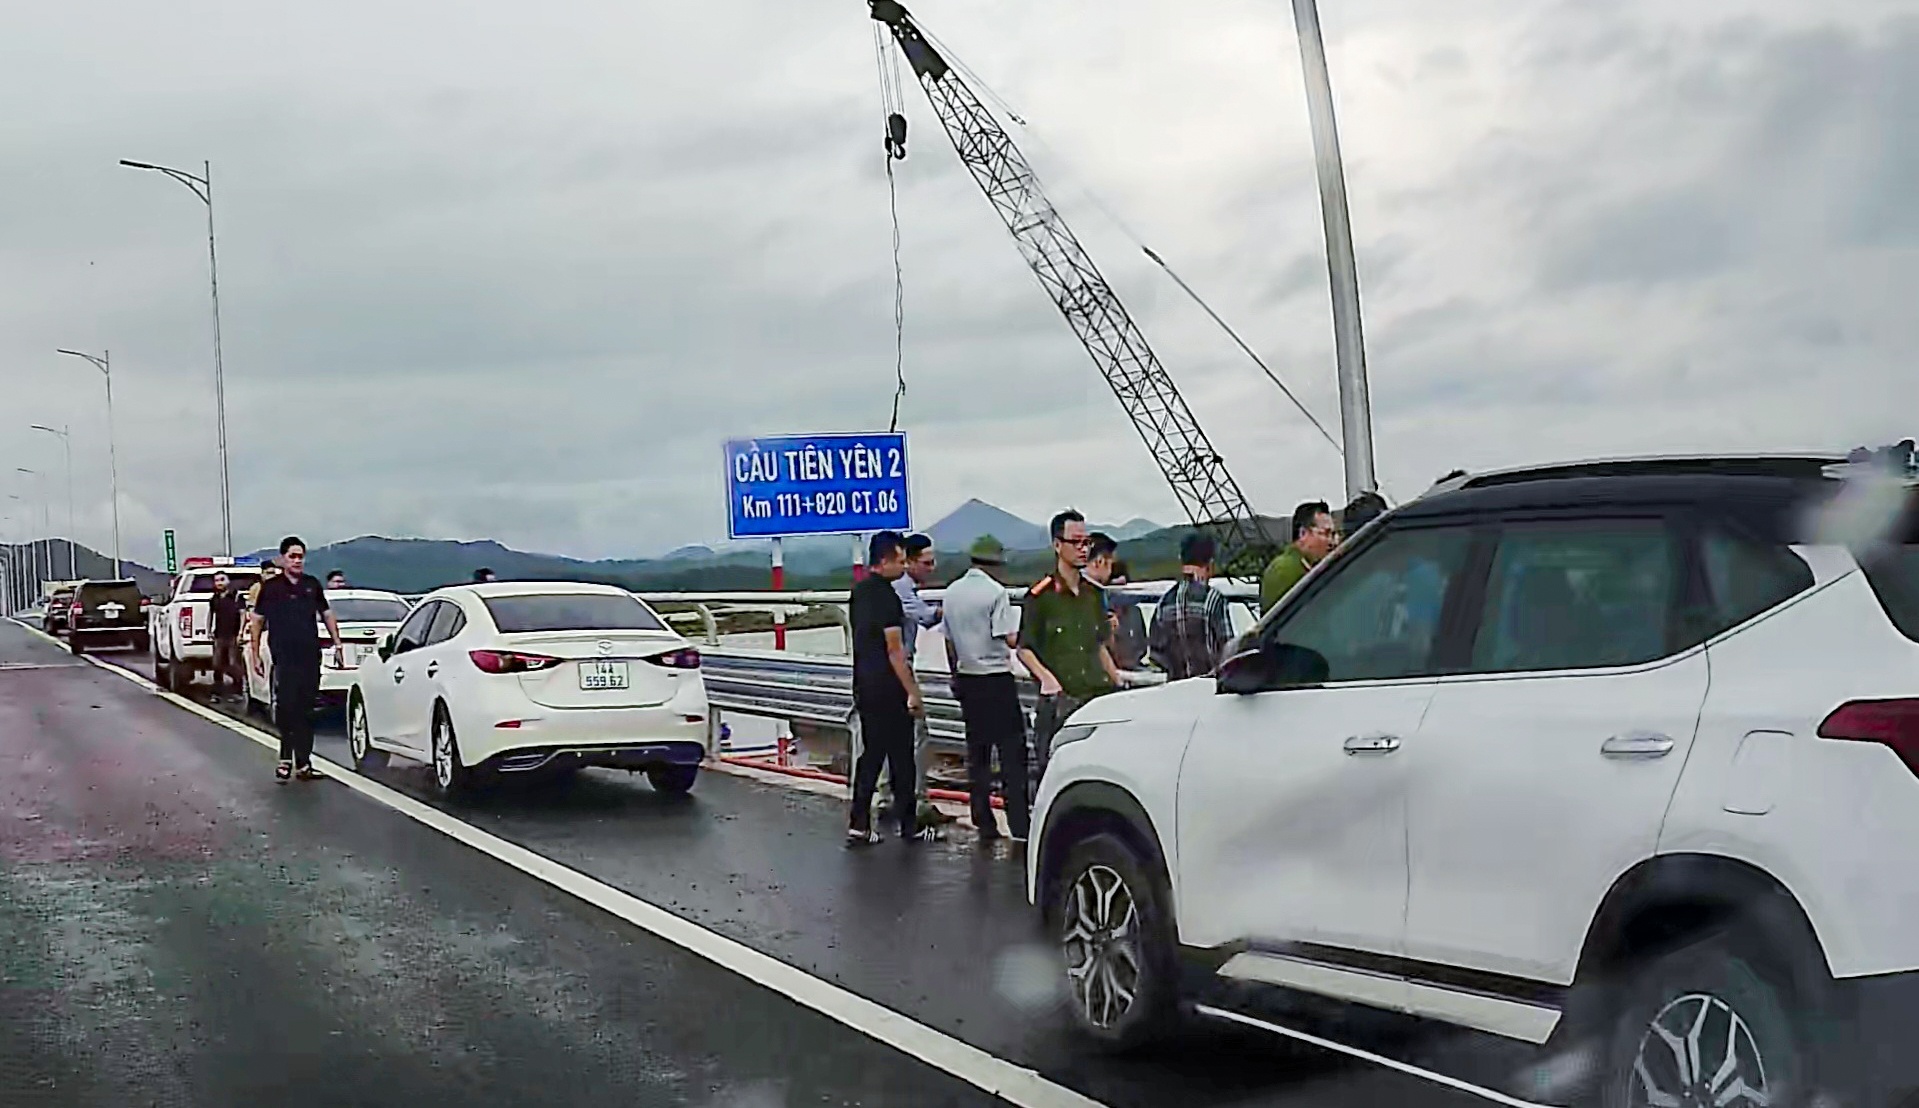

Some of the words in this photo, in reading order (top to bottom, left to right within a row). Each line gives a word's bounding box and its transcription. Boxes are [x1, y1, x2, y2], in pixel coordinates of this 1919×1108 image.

[735, 441, 778, 482] CẦU
[784, 444, 833, 481] TIÊN
[839, 442, 882, 479] YÊN
[888, 447, 902, 478] 2
[743, 495, 771, 518] Km
[777, 492, 846, 517] 111+820
[852, 489, 898, 514] CT.06
[595, 662, 614, 674] 14A
